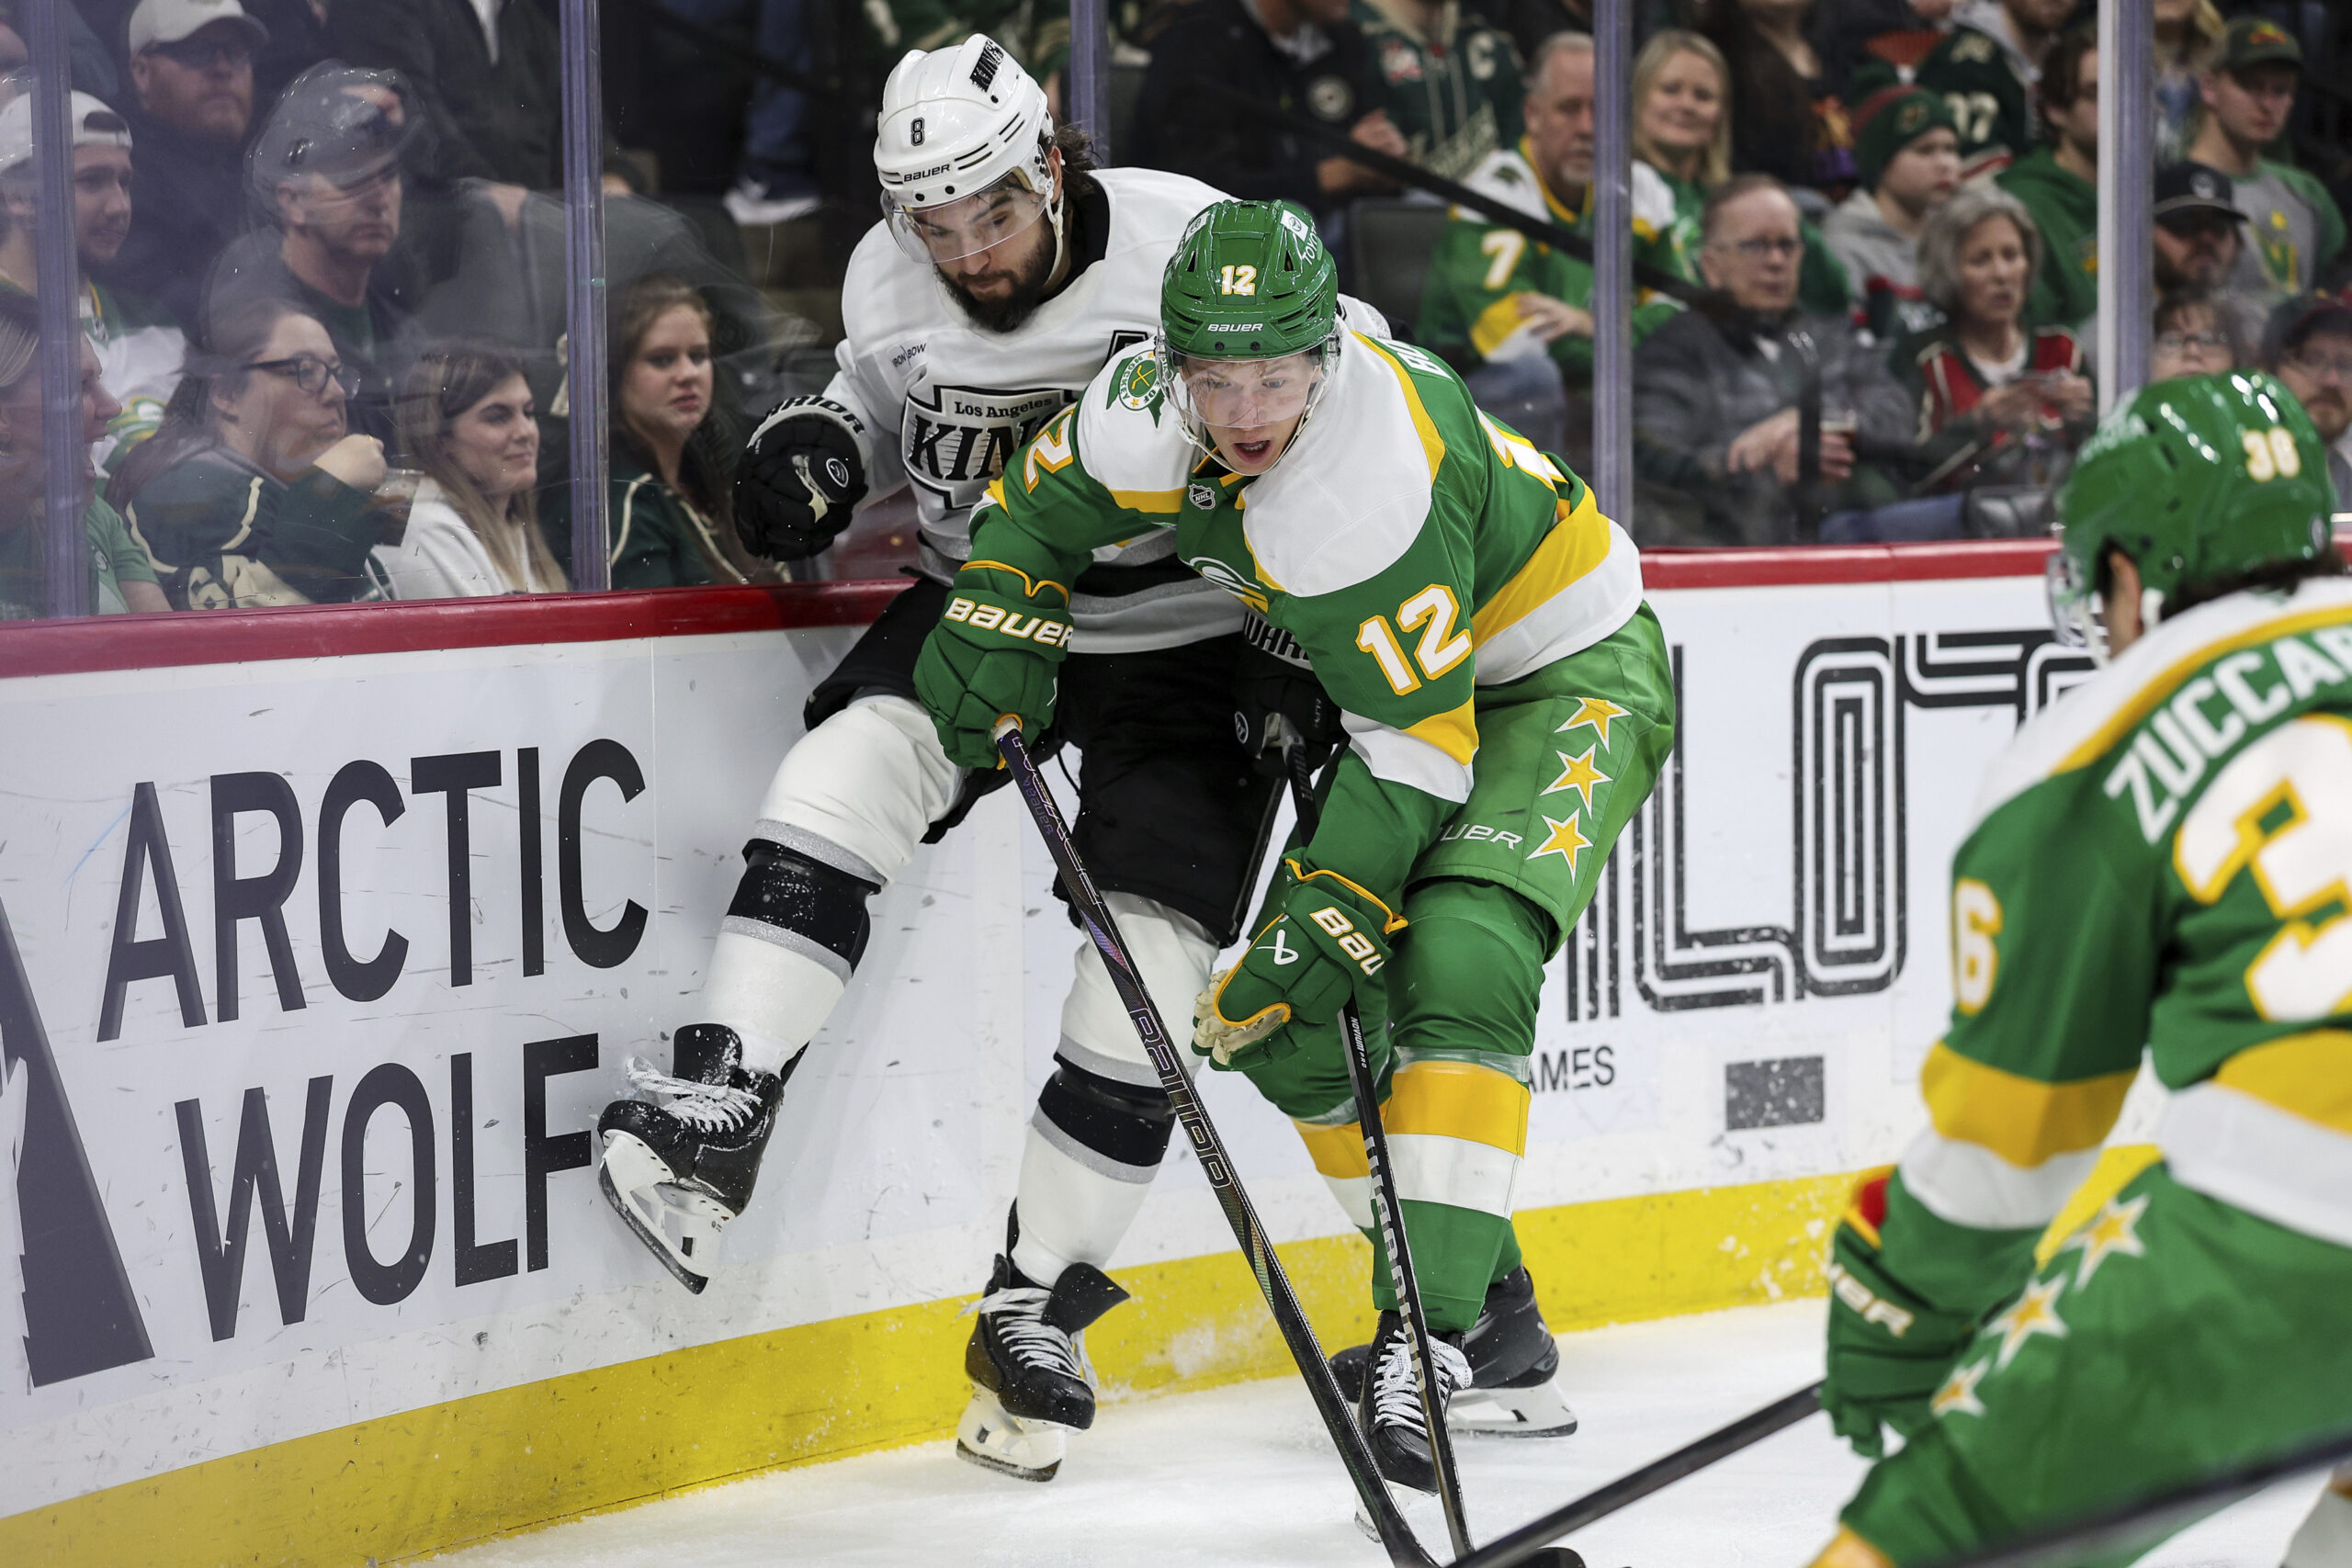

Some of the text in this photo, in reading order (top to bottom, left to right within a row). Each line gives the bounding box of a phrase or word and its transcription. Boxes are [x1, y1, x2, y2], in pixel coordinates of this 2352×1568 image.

[910, 117, 925, 146] 8
[903, 164, 951, 183] BAUER
[1480, 228, 1526, 290] 7
[1221, 265, 1257, 295] 12
[1207, 323, 1263, 333] BAUER
[954, 397, 1053, 419] Los Angeles
[1194, 492, 1210, 502] NHL
[1355, 583, 1474, 696] 12
[1439, 823, 1523, 851] UER
[96, 738, 649, 1043] ARCTIC
[175, 1032, 599, 1343] WOLF
